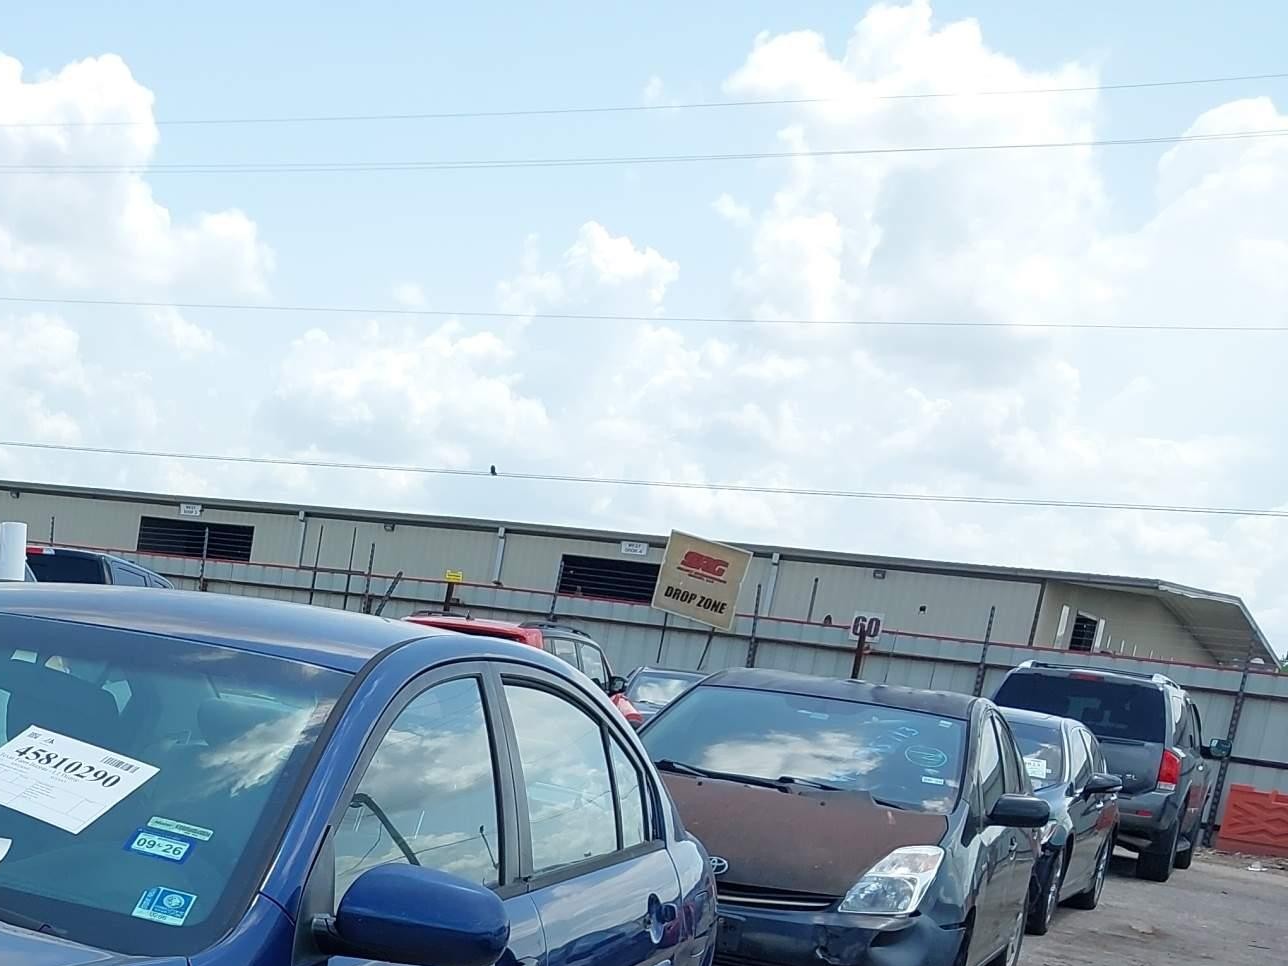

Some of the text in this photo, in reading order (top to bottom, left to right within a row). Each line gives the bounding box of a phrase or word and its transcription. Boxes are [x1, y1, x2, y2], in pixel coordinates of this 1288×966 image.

[664, 585, 728, 614] DROP ZONE
[852, 615, 882, 638] 60
[15, 745, 122, 788] 45810290
